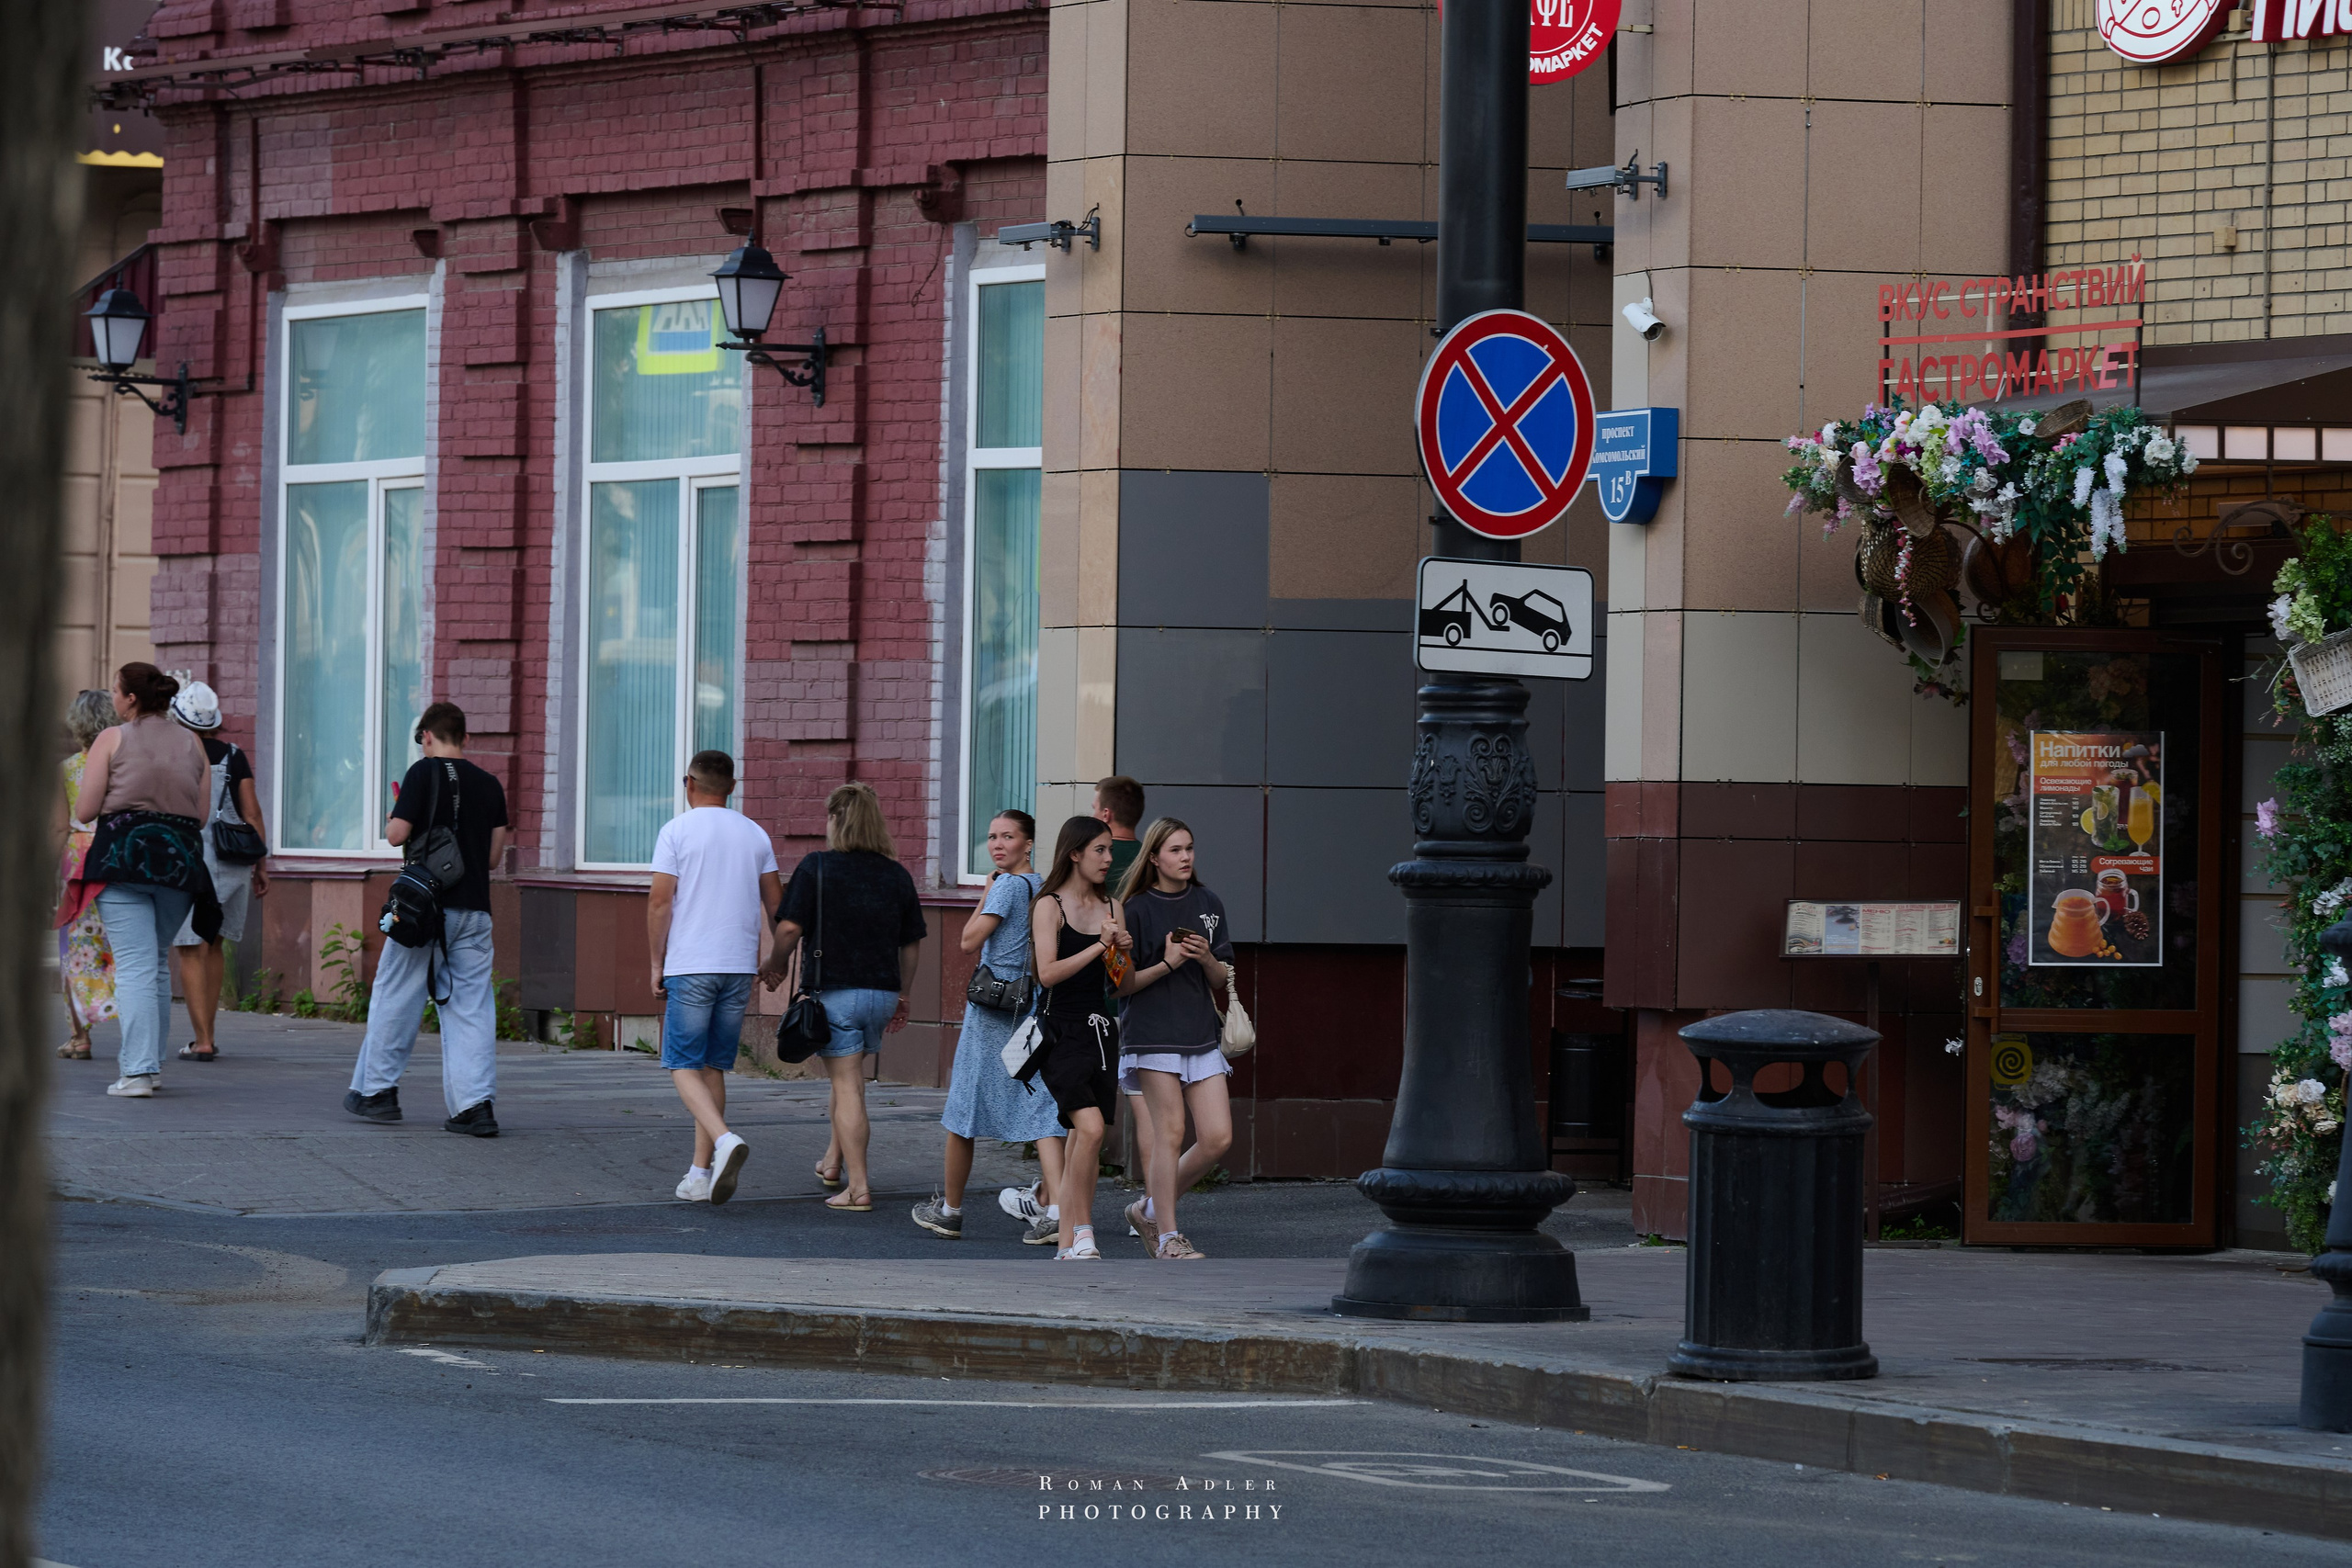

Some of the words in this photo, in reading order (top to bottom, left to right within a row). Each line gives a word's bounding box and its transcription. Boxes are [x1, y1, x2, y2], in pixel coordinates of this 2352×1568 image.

[1878, 281, 1950, 321] ВКУС
[1959, 253, 2145, 318] СТРАНСТВИЙ
[1878, 341, 2139, 403] ГАСТРОМАРКЕТ
[1601, 425, 1634, 443] проспект
[2040, 741, 2120, 758] Напитки
[2060, 758, 2092, 768] любой
[2094, 761, 2129, 769] погоды
[2040, 777, 2092, 785] Освежающие
[2098, 857, 2154, 866] Согревающие
